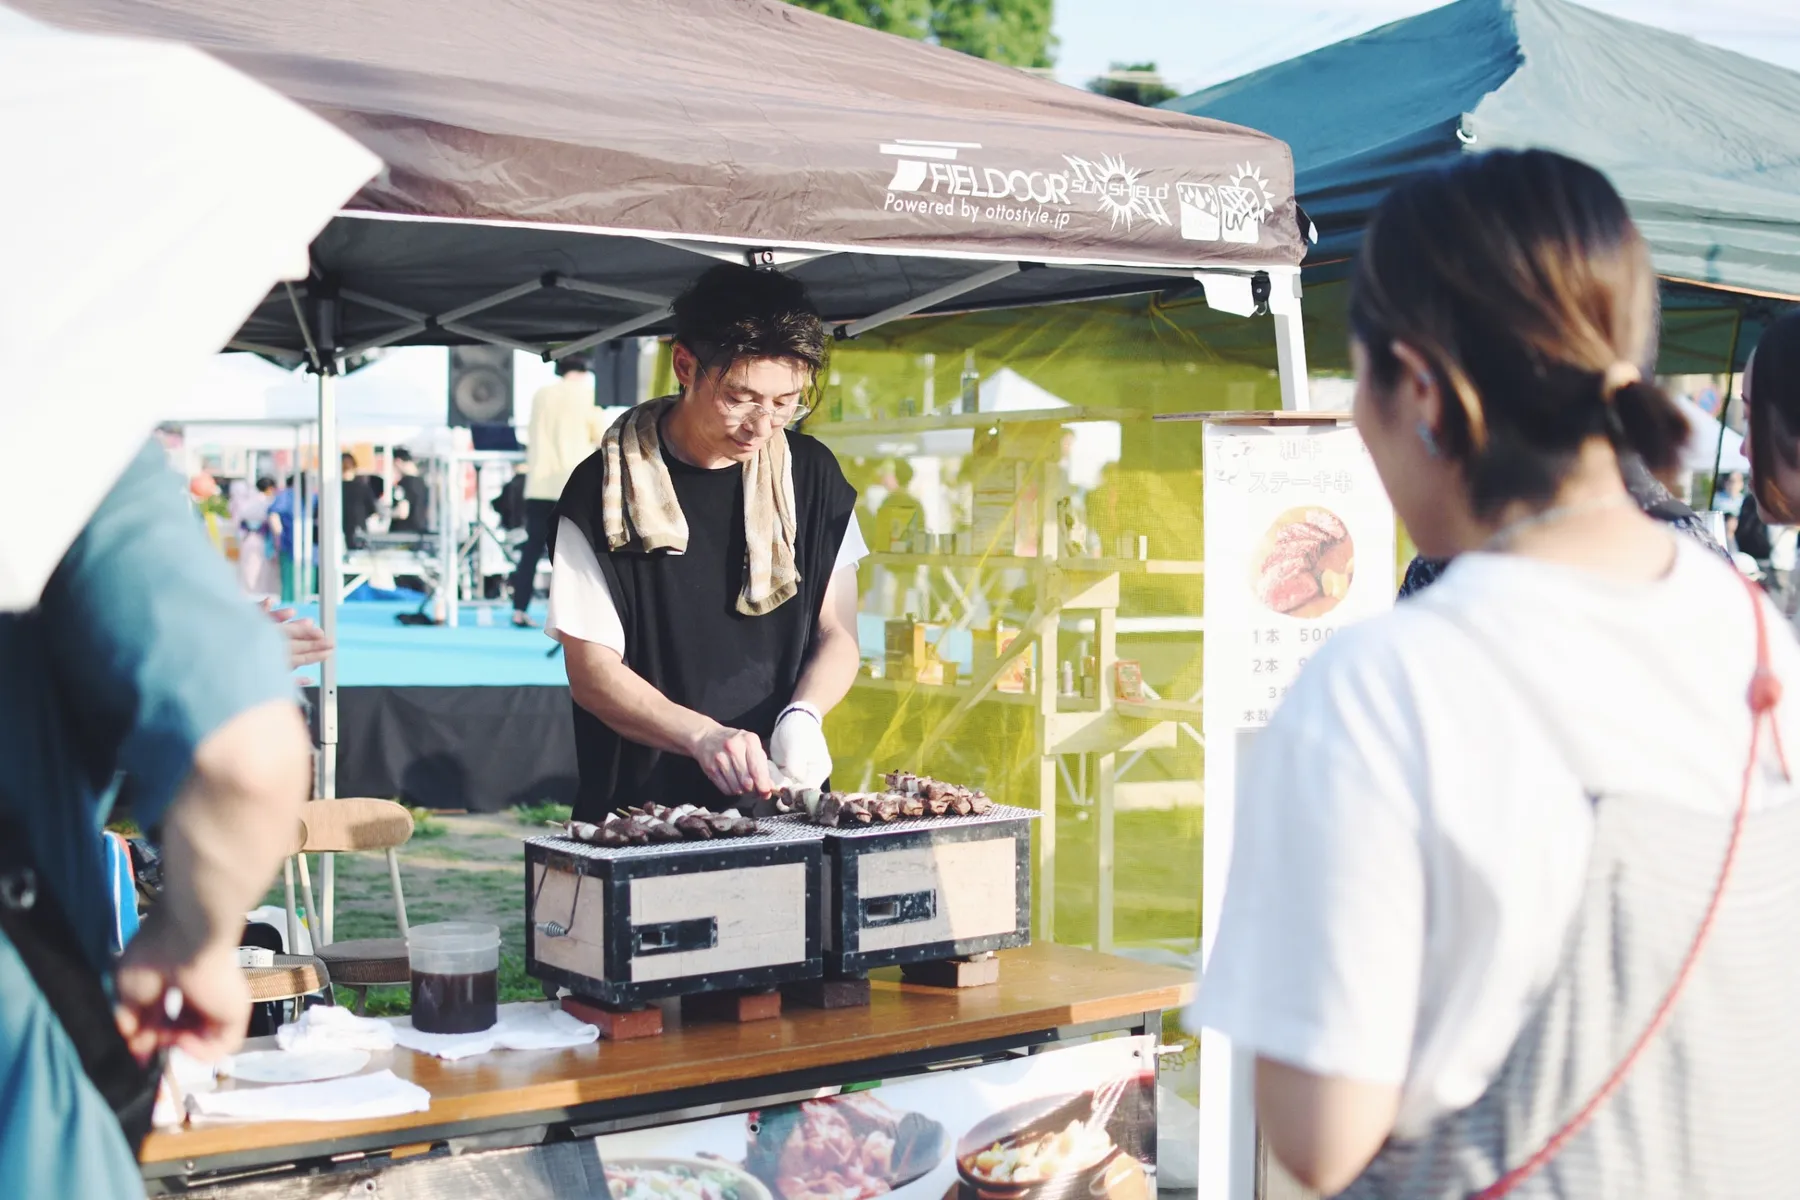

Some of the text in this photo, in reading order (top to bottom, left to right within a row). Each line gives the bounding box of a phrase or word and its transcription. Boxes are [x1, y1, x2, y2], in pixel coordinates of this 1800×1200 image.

[929, 162, 1070, 204] FIELDOOR
[884, 193, 1071, 229] Powered by ottostyle.jp
[1279, 437, 1322, 461] 和牛
[1248, 470, 1353, 494] ステーキ串
